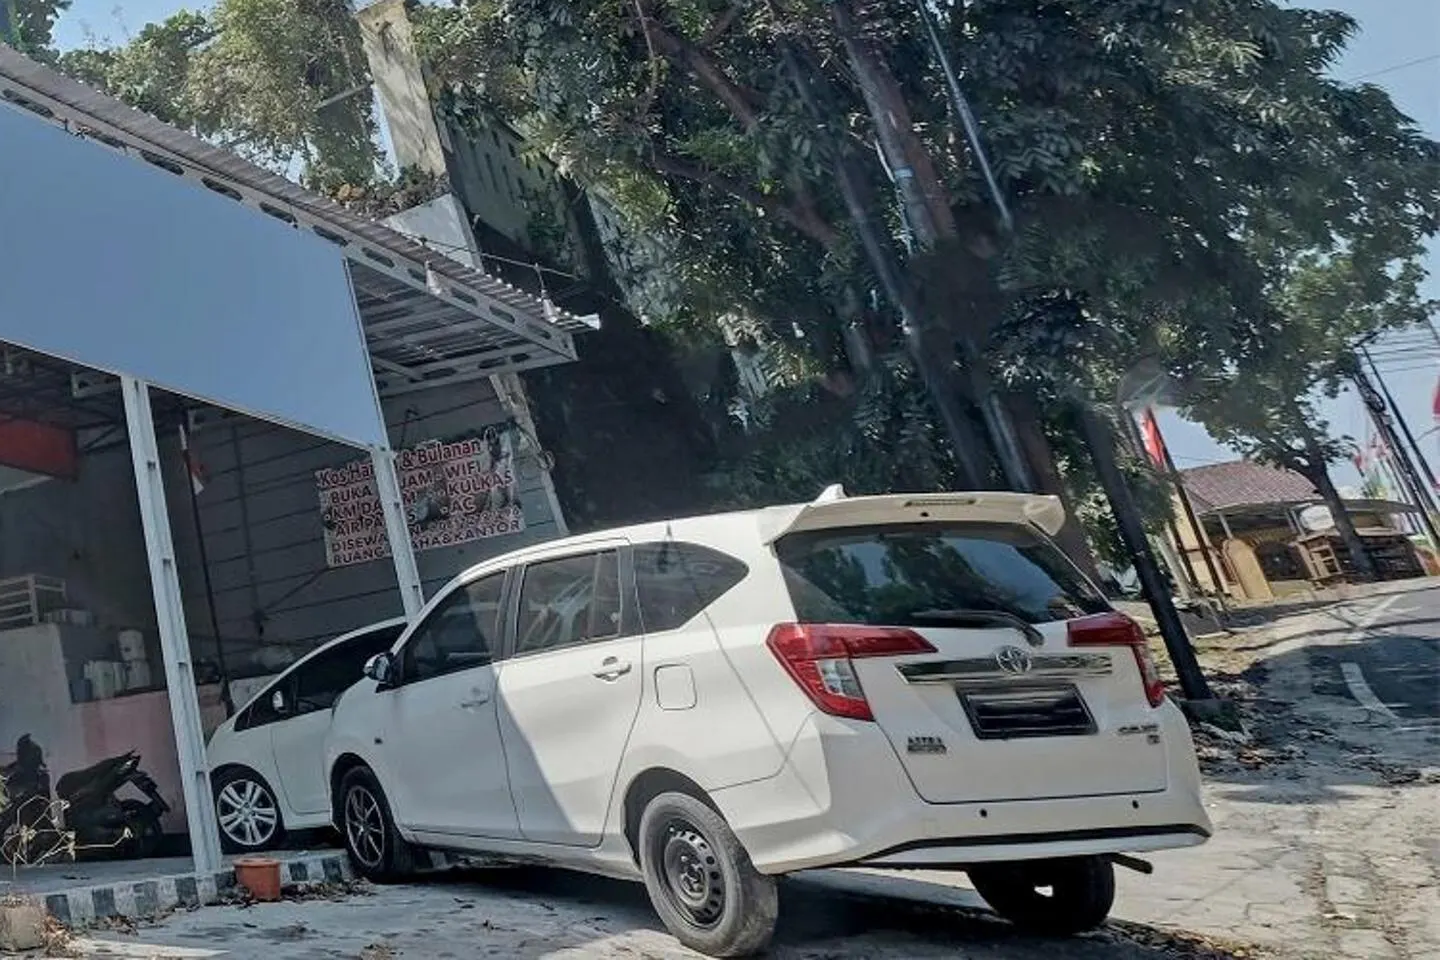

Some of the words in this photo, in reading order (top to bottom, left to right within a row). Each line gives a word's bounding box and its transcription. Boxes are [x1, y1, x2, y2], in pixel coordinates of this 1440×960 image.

[402, 450, 412, 467] &
[417, 441, 480, 463] Bulanan
[330, 485, 372, 504] BUKA
[445, 460, 480, 479] WIFI
[449, 470, 513, 495] KULKAS
[451, 497, 475, 513] AC
[334, 546, 385, 564] RUANG
